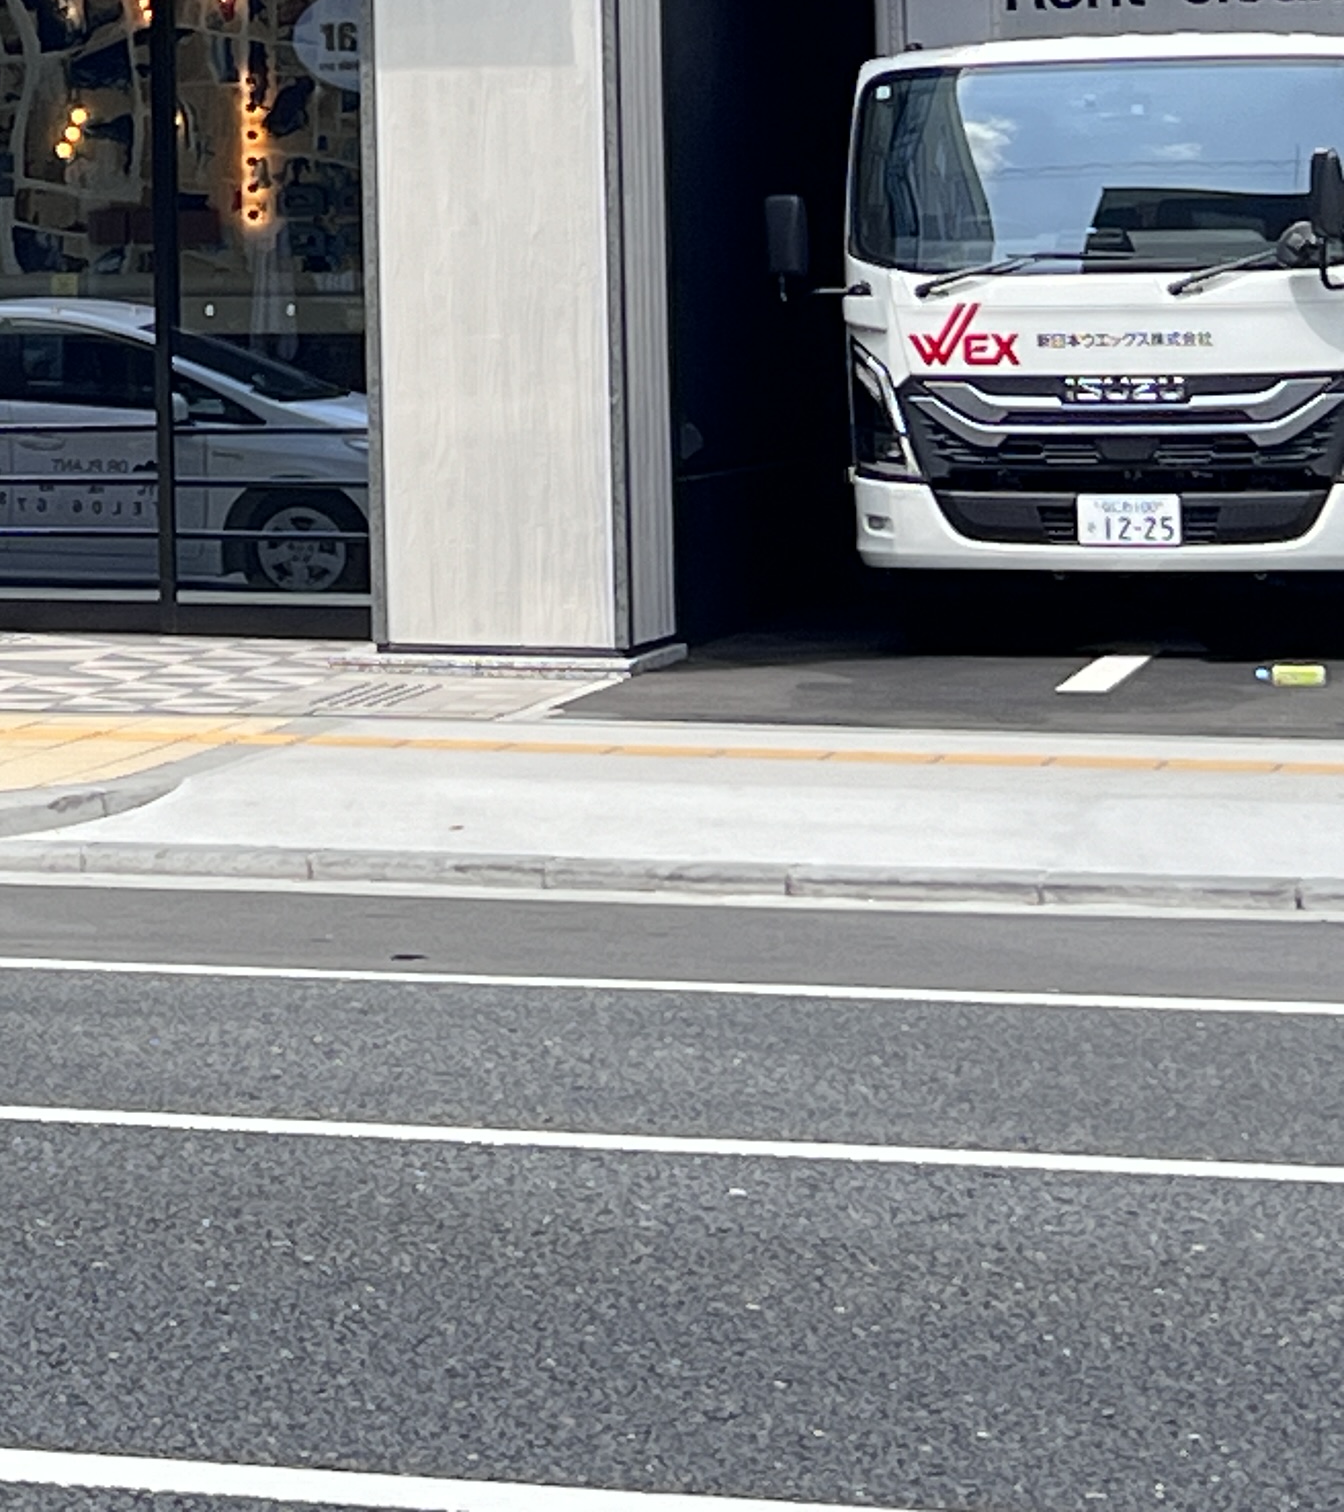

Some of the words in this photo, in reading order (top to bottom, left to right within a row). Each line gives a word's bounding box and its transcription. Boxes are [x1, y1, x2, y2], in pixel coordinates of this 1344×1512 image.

[909, 303, 1021, 365] WEX
[1064, 376, 1185, 402] ISUZU
[1104, 515, 1175, 542] 12-25
